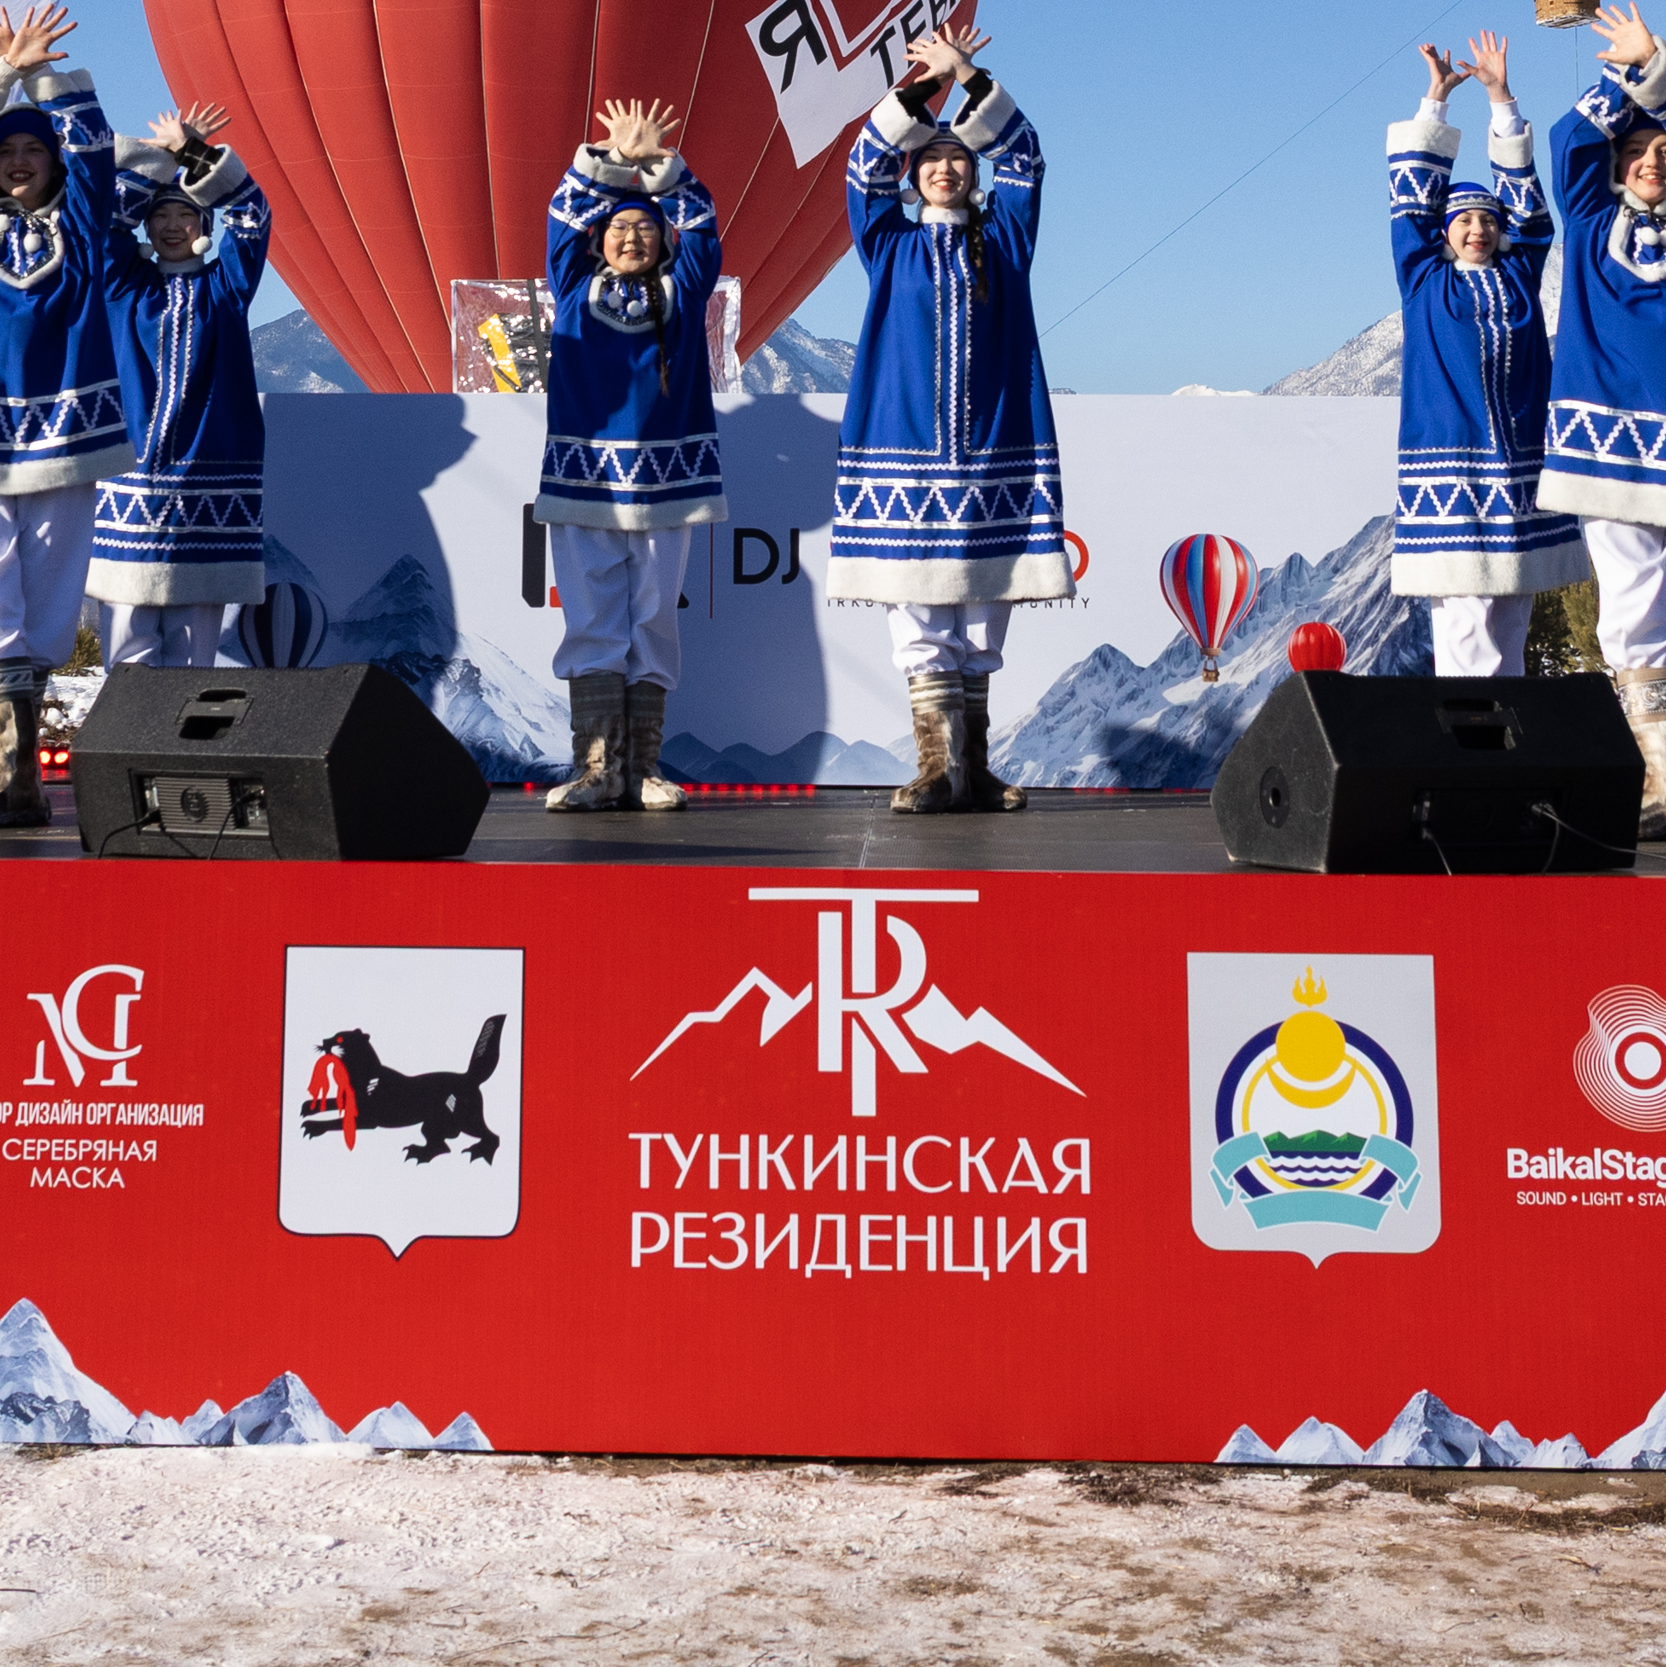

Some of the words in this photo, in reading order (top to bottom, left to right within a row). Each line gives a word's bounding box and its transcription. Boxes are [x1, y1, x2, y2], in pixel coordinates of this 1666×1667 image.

[733, 528, 800, 585] DJ
[15, 1099, 83, 1126] ДИЗАЙН
[86, 1103, 204, 1128] ОРГАНИЗАЦИЯ
[2, 1138, 157, 1162] СЕРЕБРЯНАЯ
[628, 1133, 1091, 1195] ТУНКИНСКАЯ
[30, 1166, 125, 1189] МАСКА
[1516, 1191, 1567, 1206] SOUND
[1581, 1192, 1623, 1206] LIGHT
[631, 1211, 1087, 1281] РЕЗИДЕНЦИЯ
